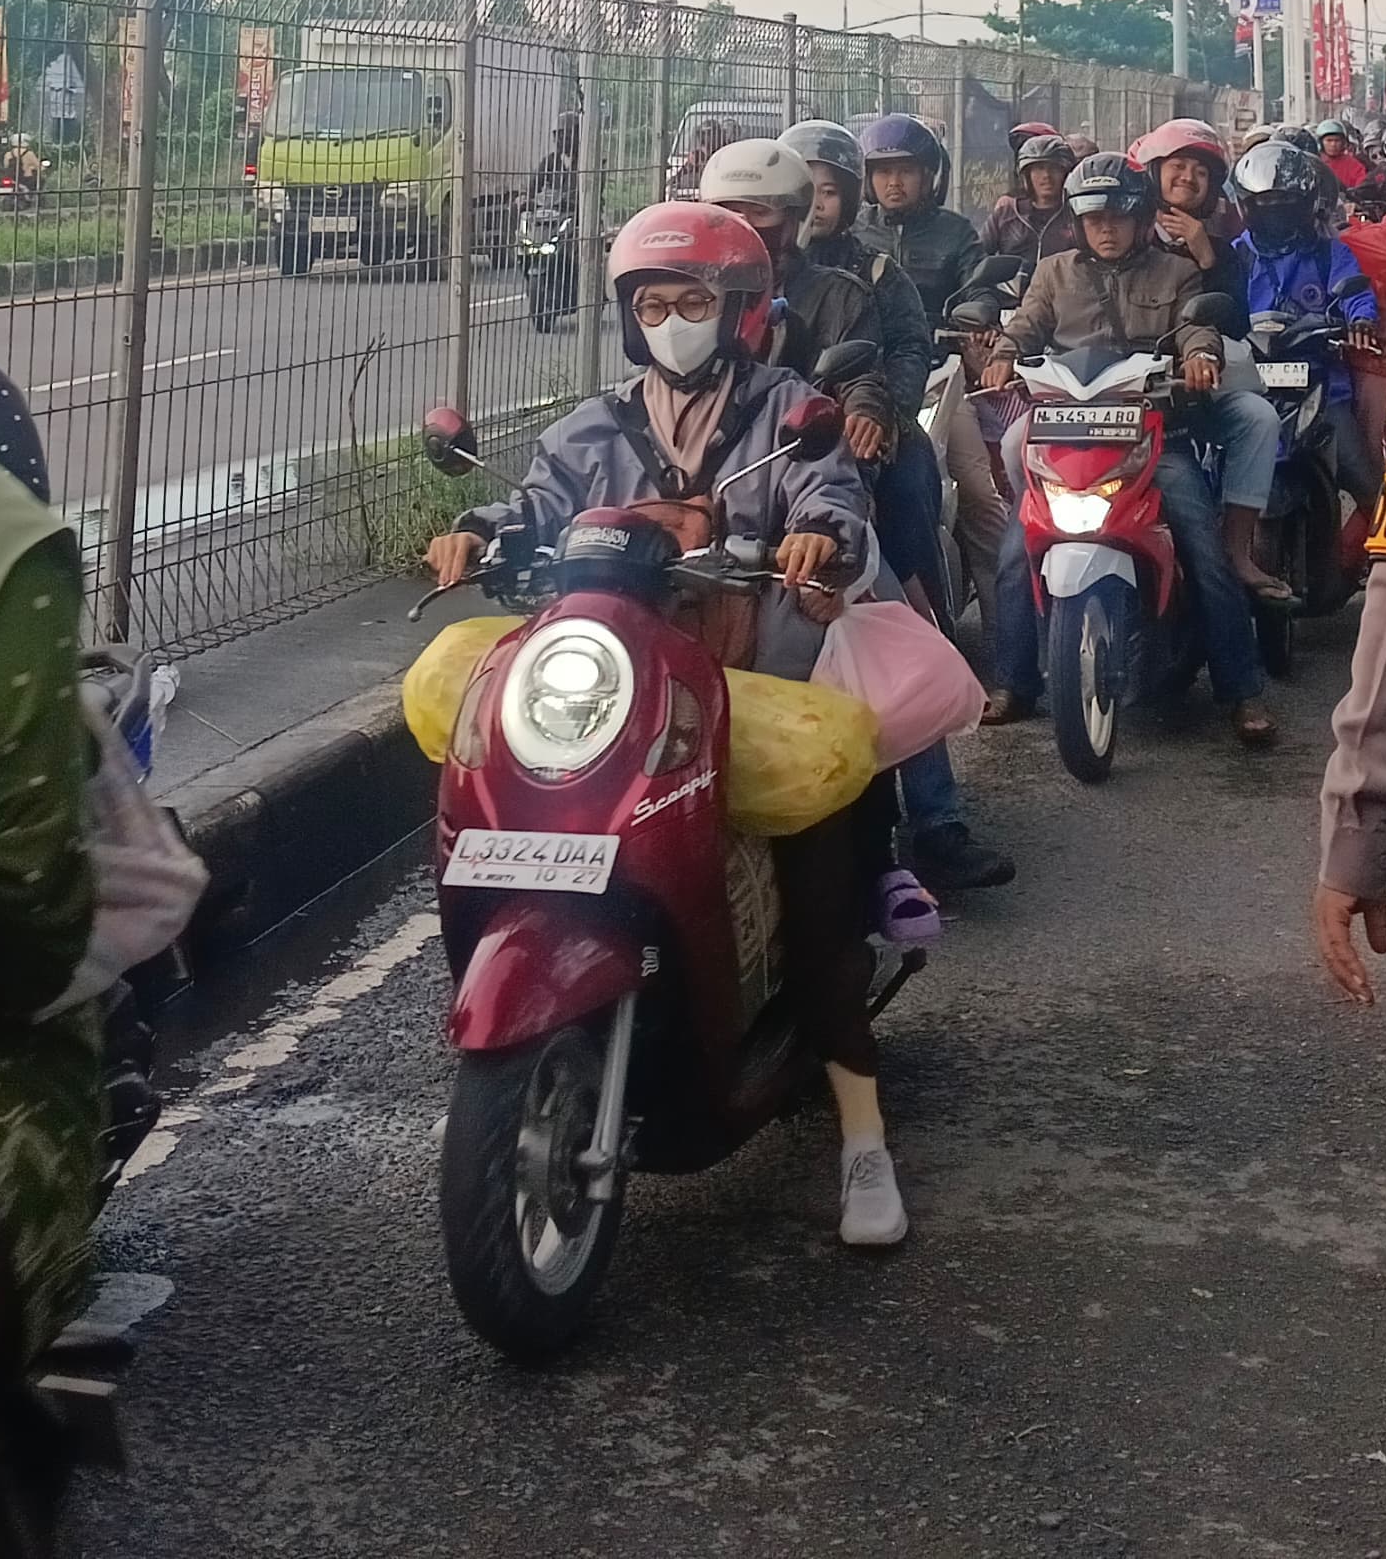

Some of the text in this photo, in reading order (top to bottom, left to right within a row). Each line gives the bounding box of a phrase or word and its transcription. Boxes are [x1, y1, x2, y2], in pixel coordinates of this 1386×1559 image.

[250, 72, 262, 109] APEL
[1055, 410, 1097, 423] 5453
[630, 769, 718, 827] Scoopy
[478, 836, 549, 863] 3324
[553, 839, 607, 867] DAA
